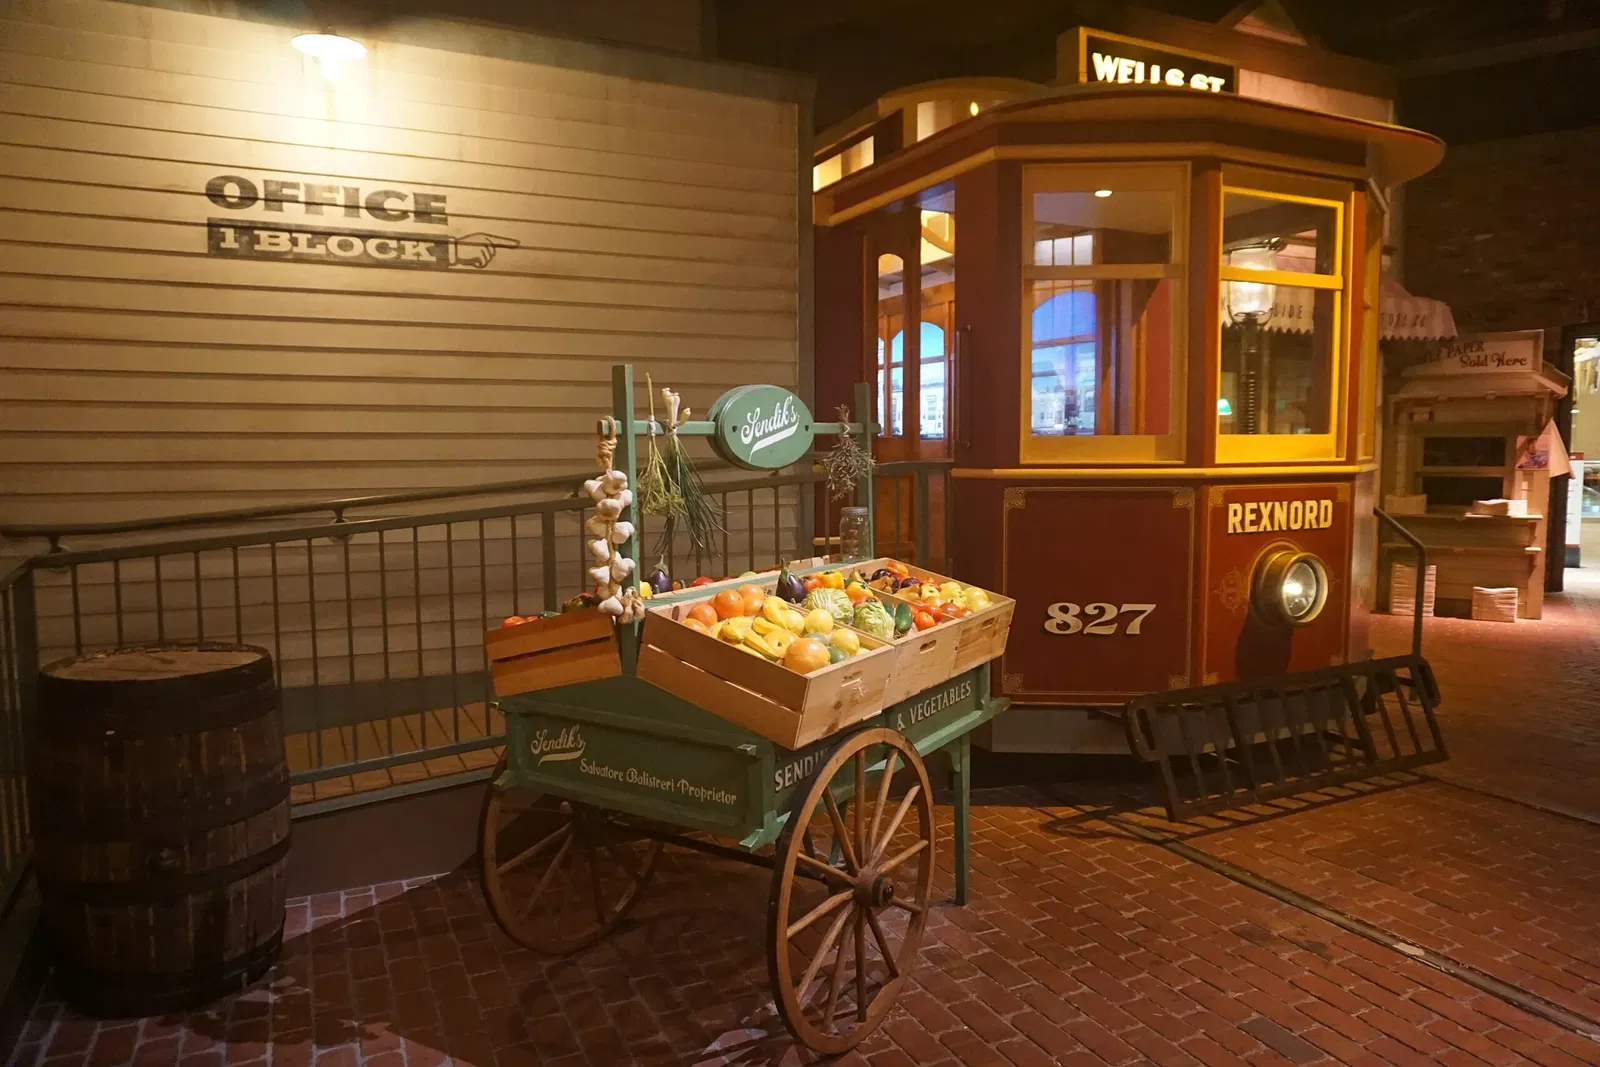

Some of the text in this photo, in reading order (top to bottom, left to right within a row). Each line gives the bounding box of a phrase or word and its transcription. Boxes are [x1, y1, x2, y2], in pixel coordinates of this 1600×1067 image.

[205, 175, 448, 226] OFFICE
[219, 228, 437, 261] 1 BLOCK
[1460, 354, 1489, 368] Sold
[1491, 349, 1528, 368] Here
[740, 394, 799, 445] Sendik's
[1227, 499, 1333, 534] REXNORD
[1044, 602, 1157, 635] 827
[897, 713, 905, 731] &
[909, 679, 972, 725] VEGETABLES
[530, 724, 586, 755] Sendik's
[580, 758, 737, 805] Salvatore Balistreri Proprietor
